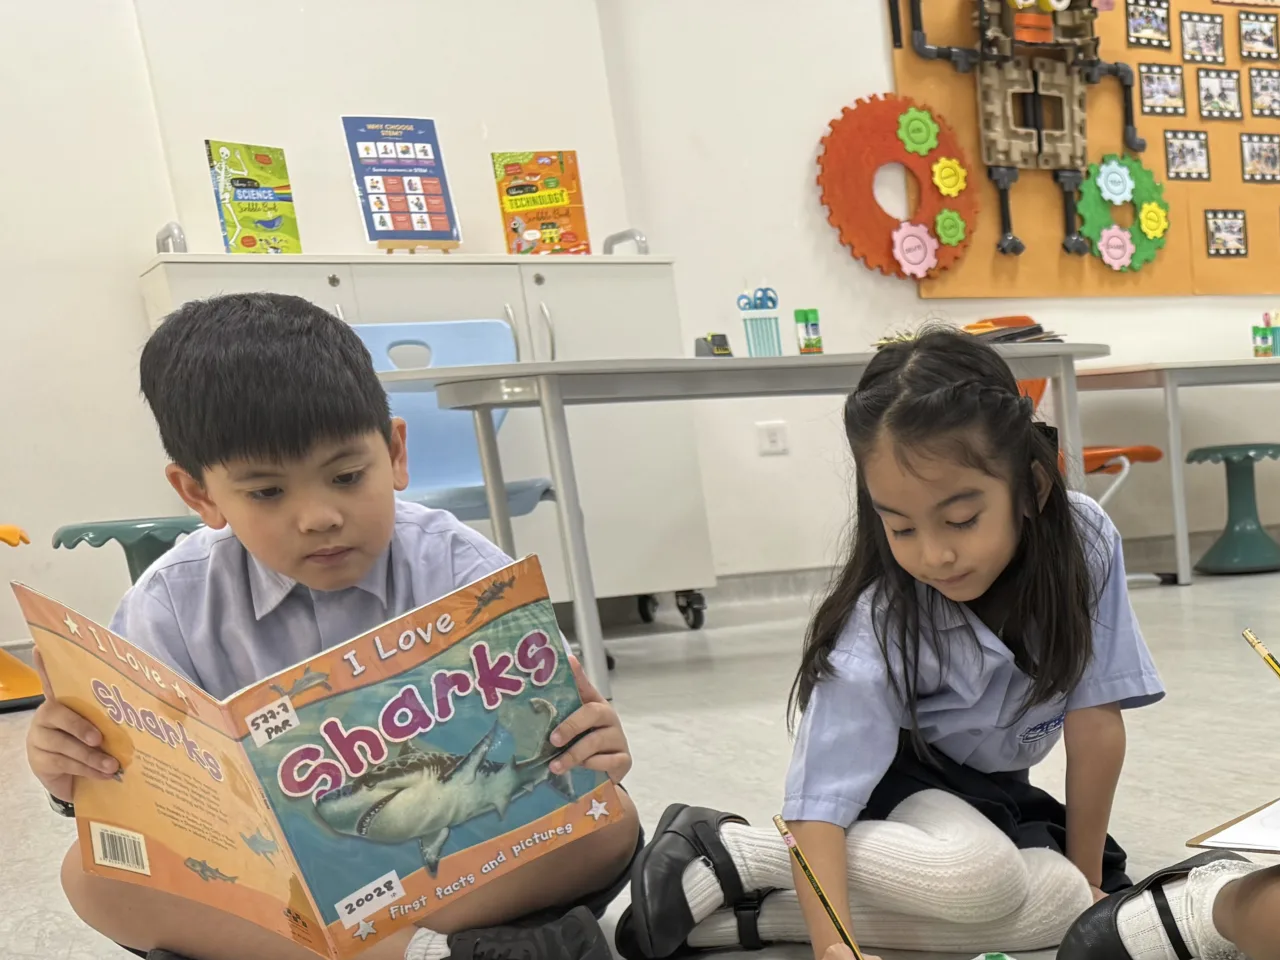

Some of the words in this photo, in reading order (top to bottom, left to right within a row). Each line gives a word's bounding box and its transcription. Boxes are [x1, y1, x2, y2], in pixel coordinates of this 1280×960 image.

[236, 189, 274, 200] SCIENCE
[507, 189, 565, 210] TECHNOLOGY
[87, 625, 107, 654] I
[109, 644, 167, 687] Love
[342, 649, 367, 678] I
[372, 612, 456, 662] Love
[90, 677, 225, 783] Sharks
[264, 717, 297, 744] PAR
[277, 627, 560, 802] Sharks
[388, 892, 430, 922] First
[434, 870, 477, 903] facts
[479, 849, 509, 878] and
[511, 820, 575, 862] pictures
